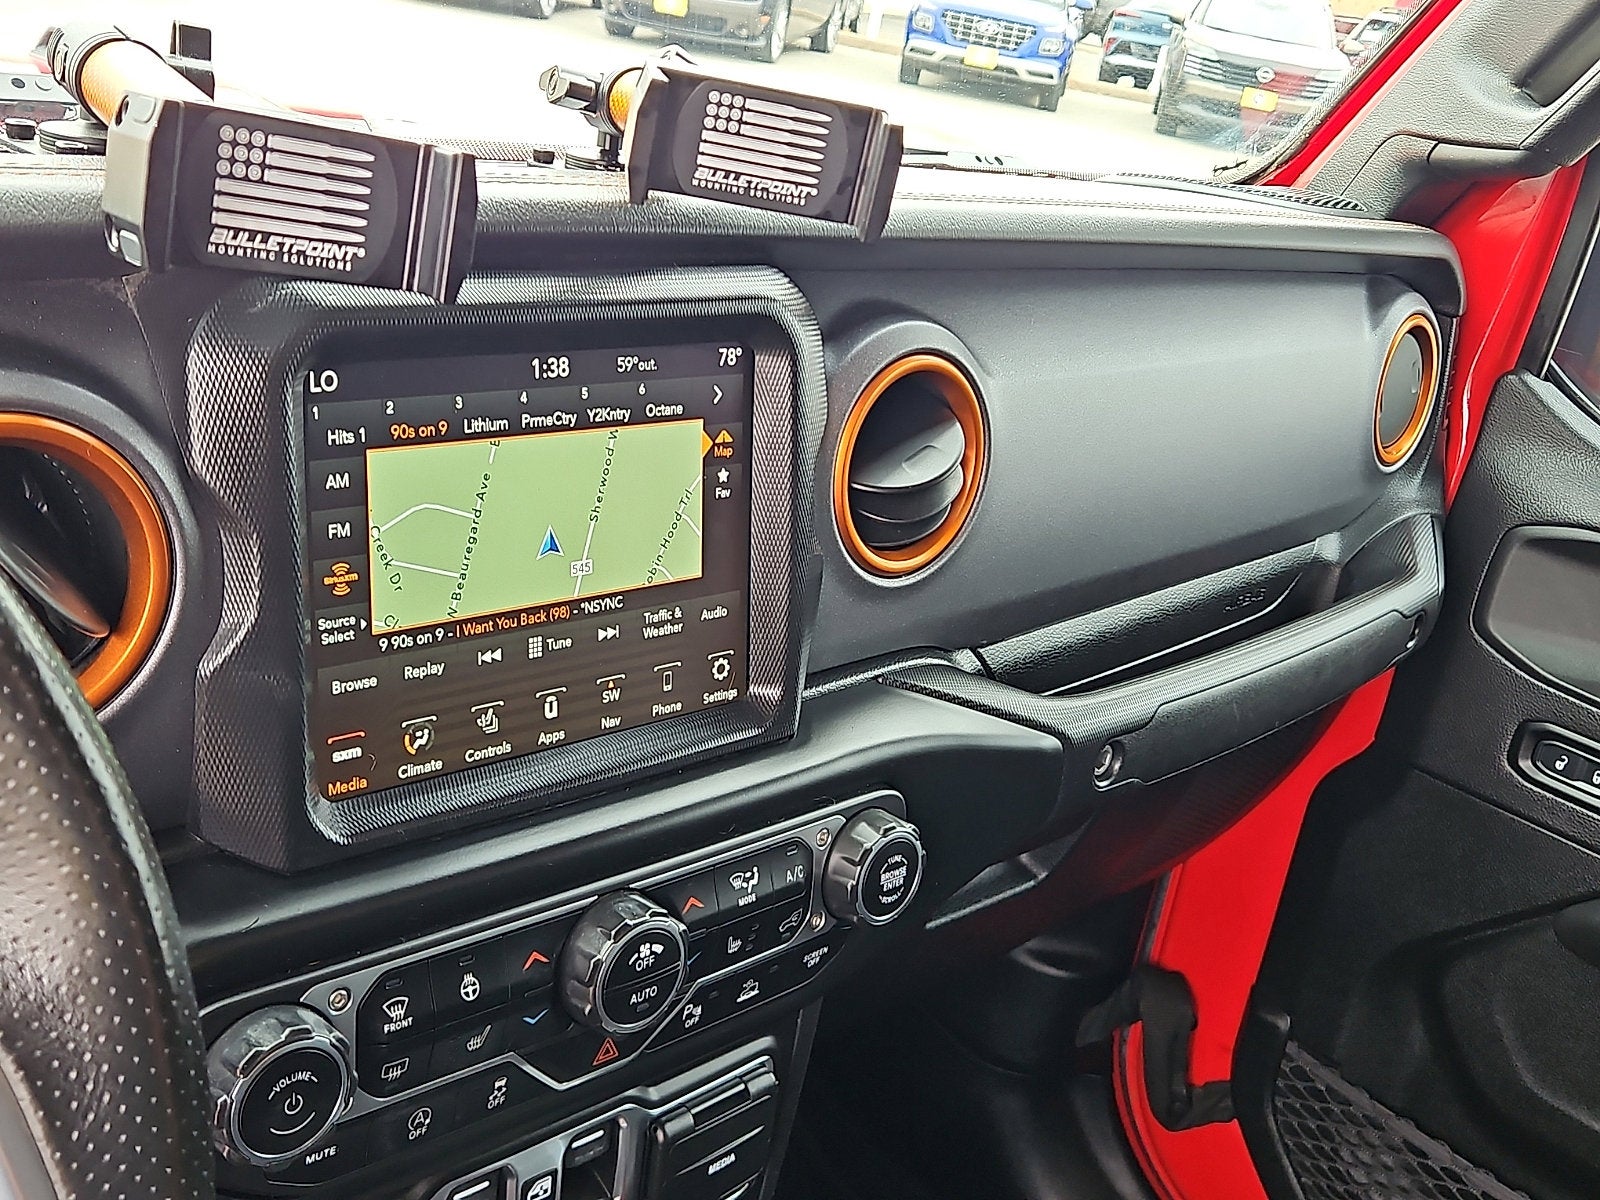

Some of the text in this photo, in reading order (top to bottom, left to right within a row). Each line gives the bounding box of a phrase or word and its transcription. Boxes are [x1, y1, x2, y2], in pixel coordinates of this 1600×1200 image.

[692, 178, 806, 206] MOUNTING SOLUTIONS
[207, 242, 352, 272] MOUNTING SOLUTIONS
[532, 356, 570, 380] 1:38
[308, 370, 338, 393] LO
[638, 382, 646, 396] 6
[520, 391, 528, 404] 4
[581, 386, 588, 400] 5
[385, 400, 394, 414] 2
[454, 396, 463, 410] 3
[646, 404, 683, 418] Octane
[312, 406, 319, 420] 1
[521, 412, 577, 428] PrmeCtry
[586, 407, 631, 424] Y2Kntry
[390, 421, 448, 440] 90s on 9
[464, 417, 509, 434] Lithium
[327, 428, 366, 446] Hits 1
[714, 446, 733, 458] Map
[325, 473, 350, 490] AM
[590, 447, 614, 522] Sherwood
[716, 488, 730, 499] Fav
[328, 522, 351, 540] FM
[450, 508, 482, 602] Beauregard
[476, 472, 491, 502] Ave
[644, 488, 693, 584] obin Hood Trl
[371, 526, 402, 592] Creek Dr
[572, 562, 592, 574] 545
[644, 606, 682, 625] Traffic &
[700, 606, 728, 622] Audio
[318, 616, 356, 631] Source
[378, 638, 388, 652] 9
[392, 634, 414, 650] 90s
[416, 631, 432, 644] on
[434, 628, 444, 642] 9
[463, 620, 494, 636] Want
[496, 615, 518, 631] You
[520, 610, 547, 626] Back
[549, 606, 570, 622] (98)
[642, 622, 684, 640] Weather
[321, 631, 356, 646] Select
[546, 637, 572, 652] Tune
[404, 662, 445, 680] Replay
[331, 676, 378, 695] Browse
[602, 688, 621, 704] SW
[702, 688, 738, 705] Settings
[652, 701, 682, 717] Phone
[601, 715, 622, 730] Nav
[538, 730, 566, 746] Apps
[464, 741, 512, 763] Controls
[398, 759, 443, 779] Climate
[328, 776, 368, 796] Media
[786, 866, 804, 884] A/C
[881, 866, 907, 880] BROWSE
[883, 878, 904, 892] ENTER
[738, 894, 756, 906] MODE
[636, 956, 655, 972] OFF
[630, 986, 658, 1006] AUTO
[384, 1016, 414, 1034] FRONT
[684, 1016, 700, 1028] OFF
[272, 1072, 312, 1093] VOLUME
[488, 1094, 506, 1110] OFF
[408, 1126, 428, 1140] OFF
[306, 1146, 337, 1164] MUTE
[708, 1152, 736, 1174] MEDIA
